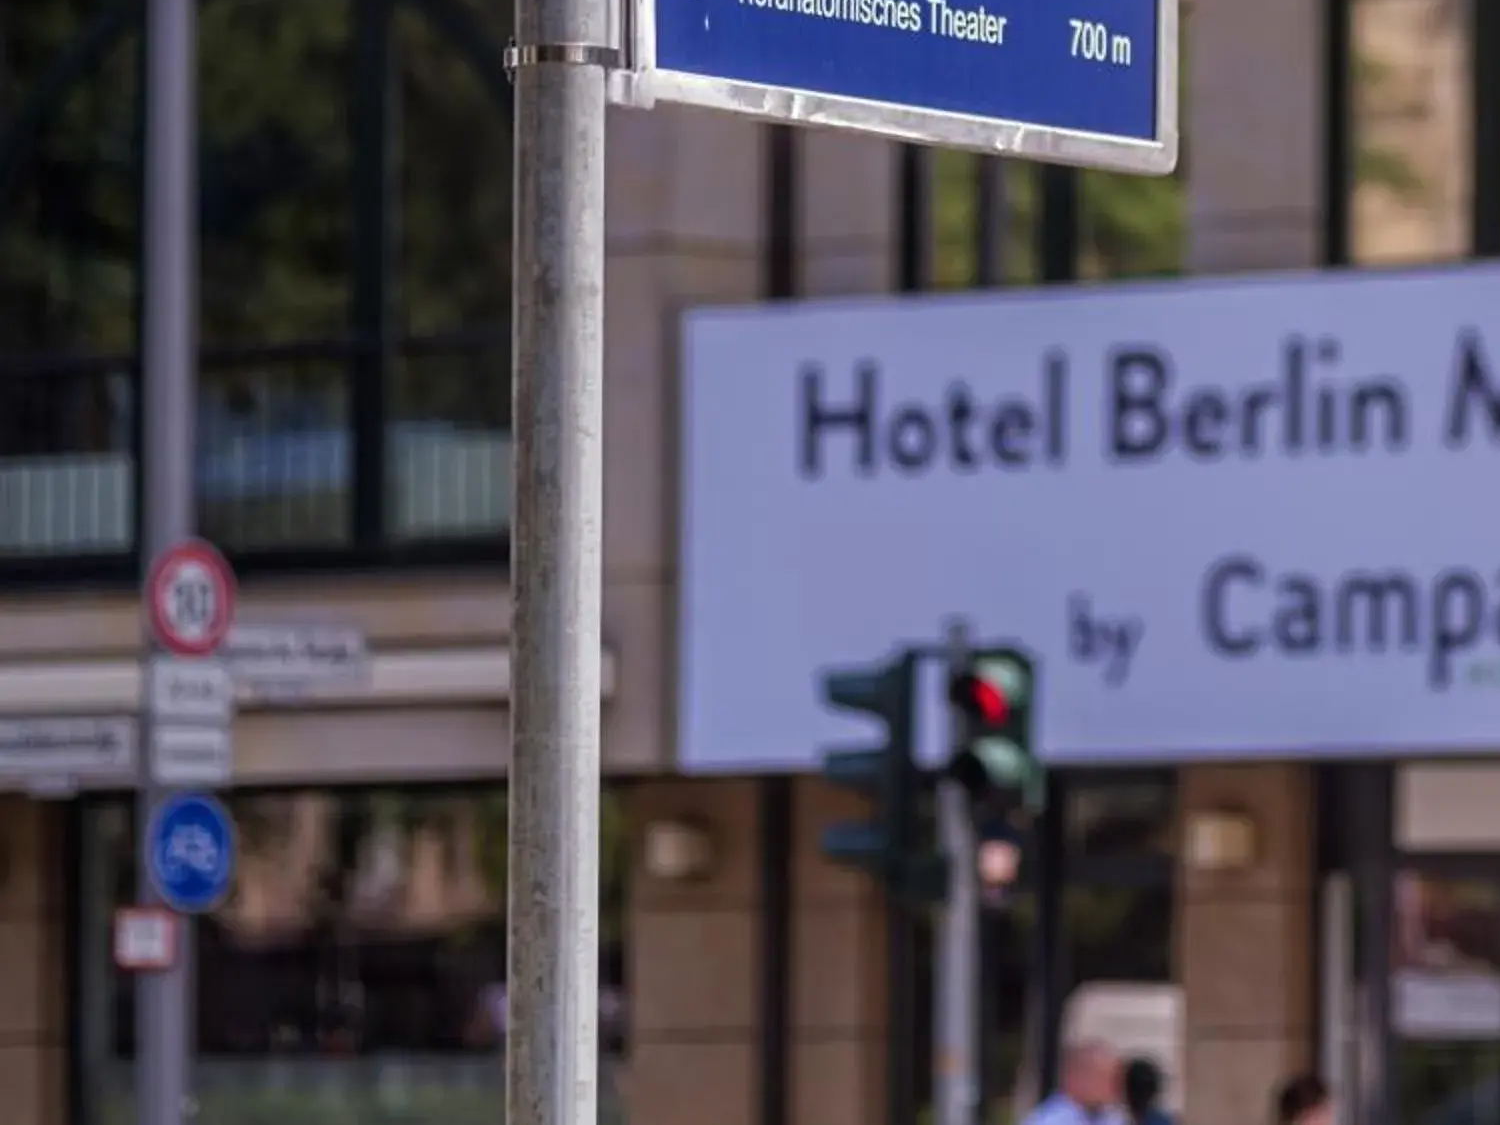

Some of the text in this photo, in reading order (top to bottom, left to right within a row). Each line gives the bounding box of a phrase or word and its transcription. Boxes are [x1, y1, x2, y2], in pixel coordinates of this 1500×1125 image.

[1069, 18, 1108, 62] 700
[1111, 34, 1132, 66] m
[800, 355, 1067, 477] Hotel
[1107, 342, 1406, 462] Berlin
[1070, 595, 1140, 683] by
